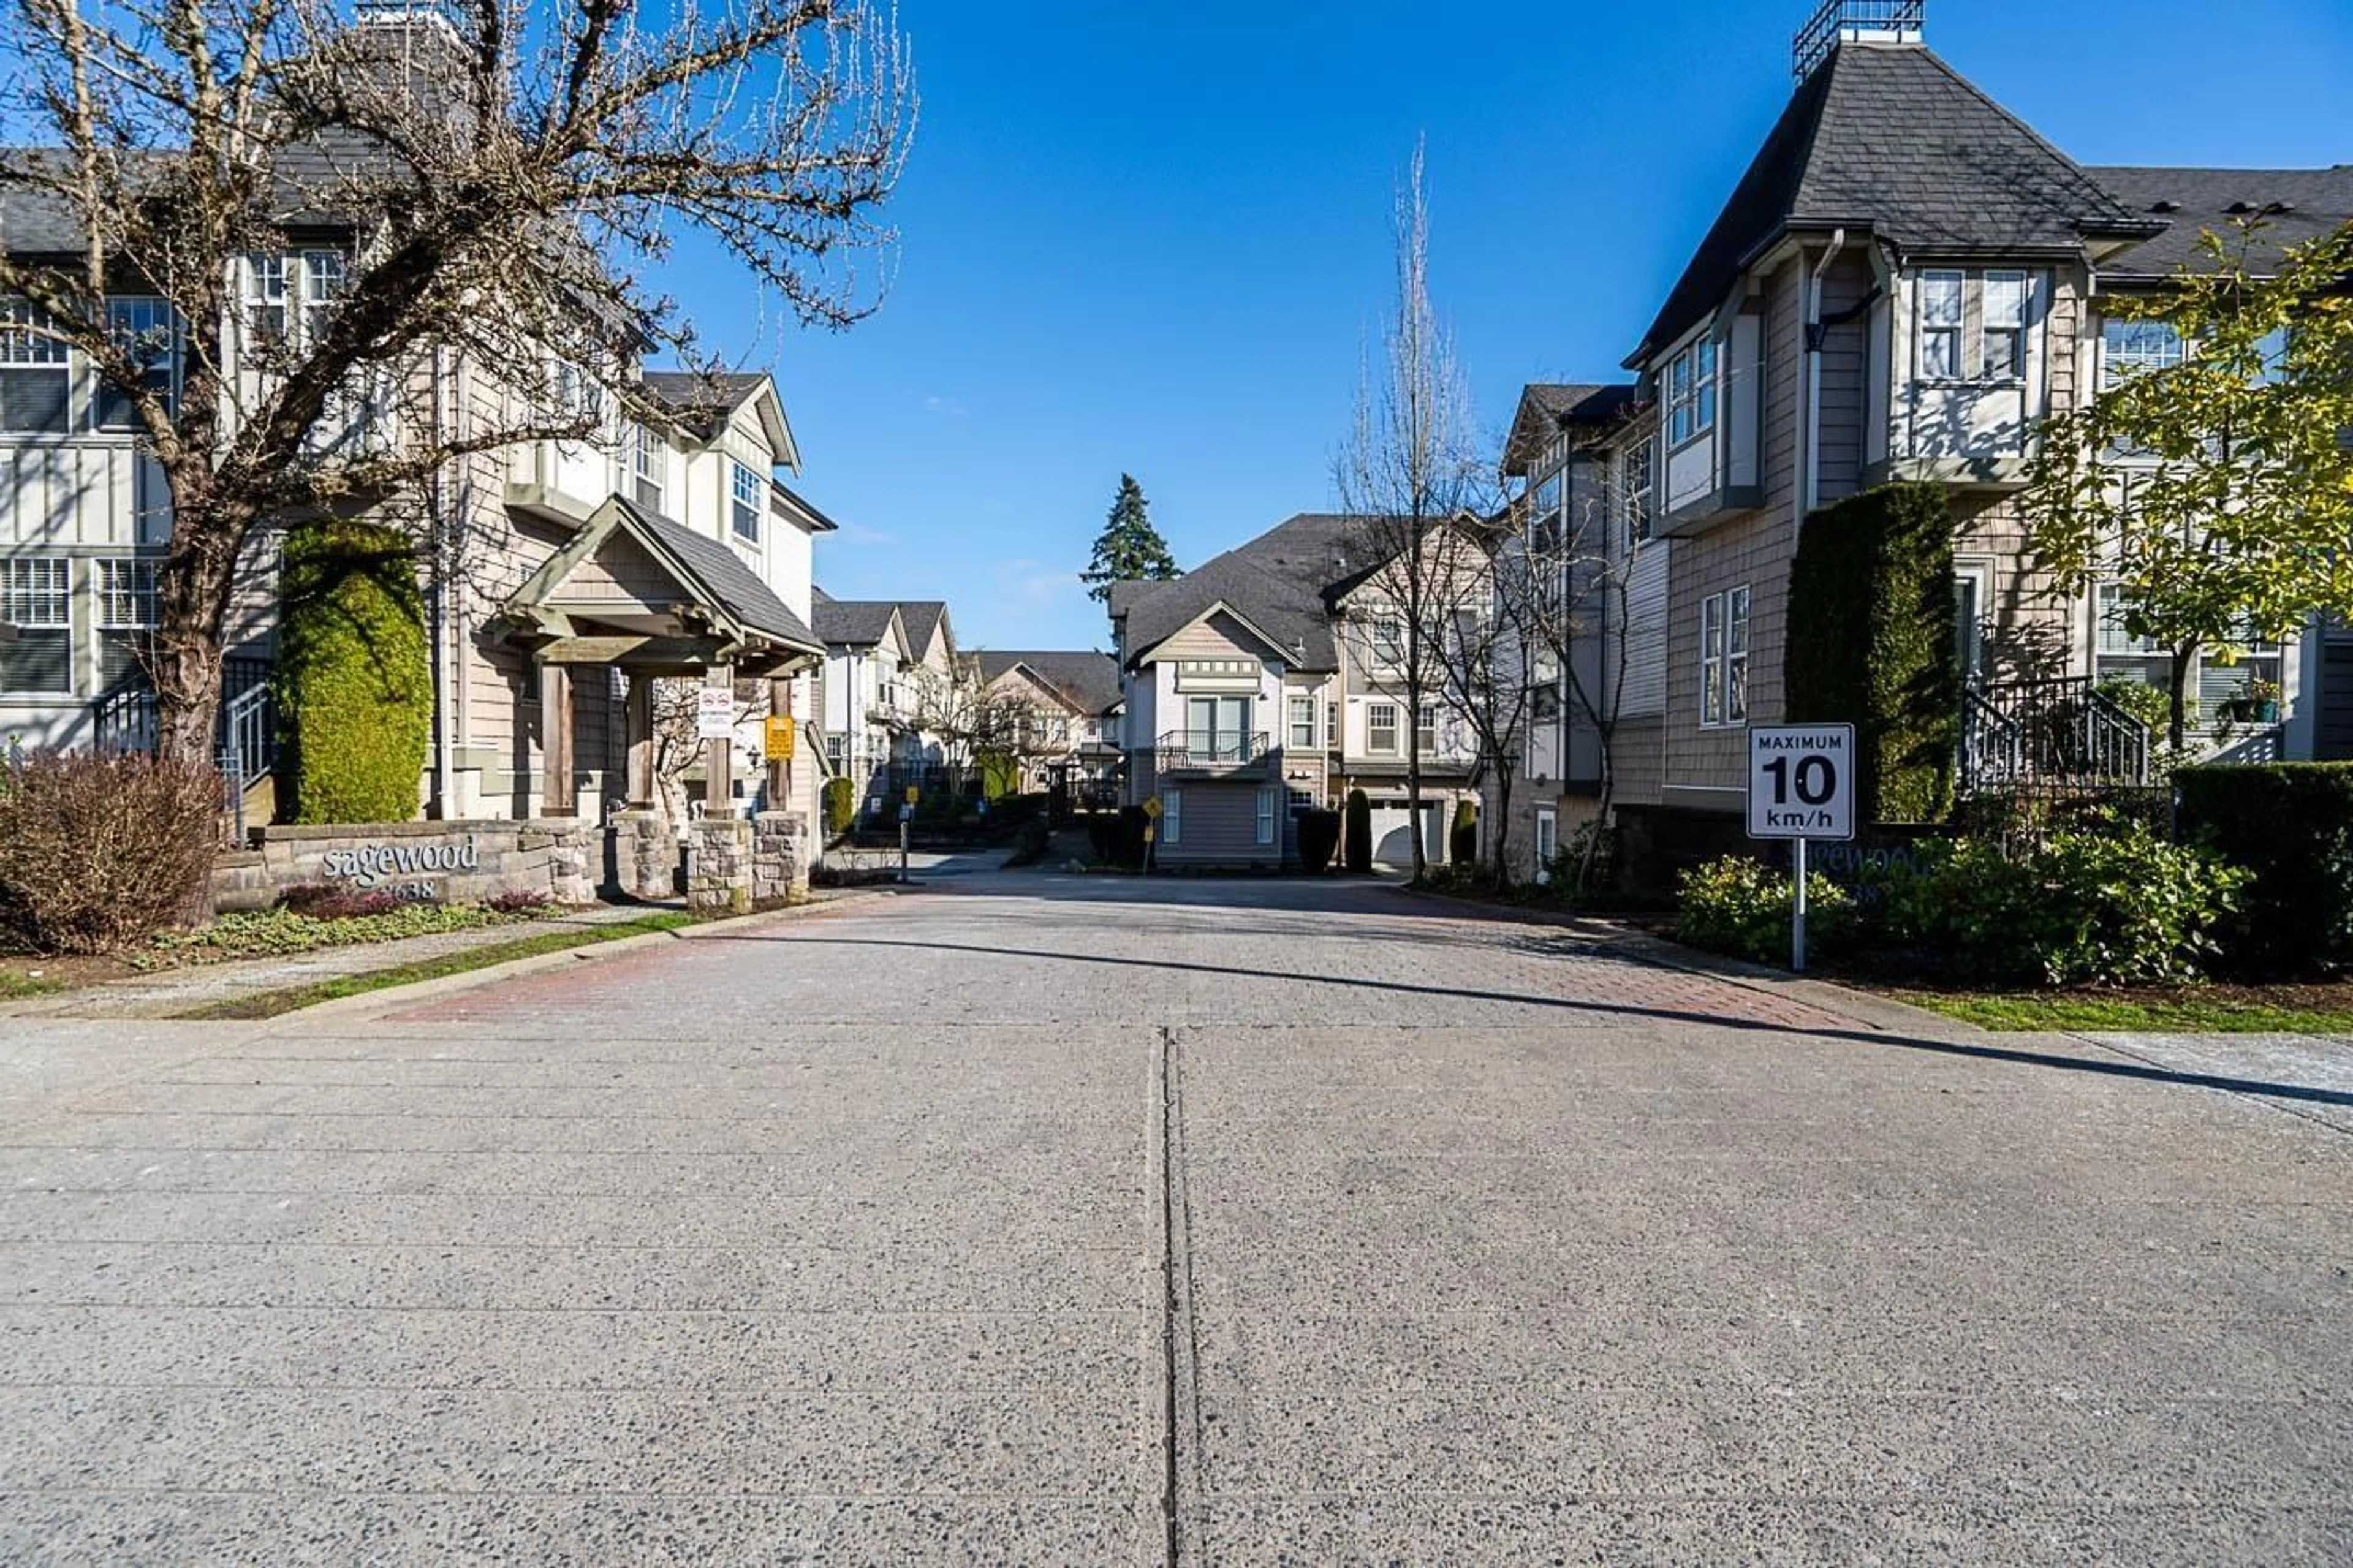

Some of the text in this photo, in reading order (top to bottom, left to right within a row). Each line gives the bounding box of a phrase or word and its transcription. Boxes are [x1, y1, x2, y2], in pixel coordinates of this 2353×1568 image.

[1759, 735, 1841, 749] MAXIMUM
[1762, 755, 1836, 805] 10
[1767, 809, 1832, 827] km/h
[323, 834, 479, 887] sagewood
